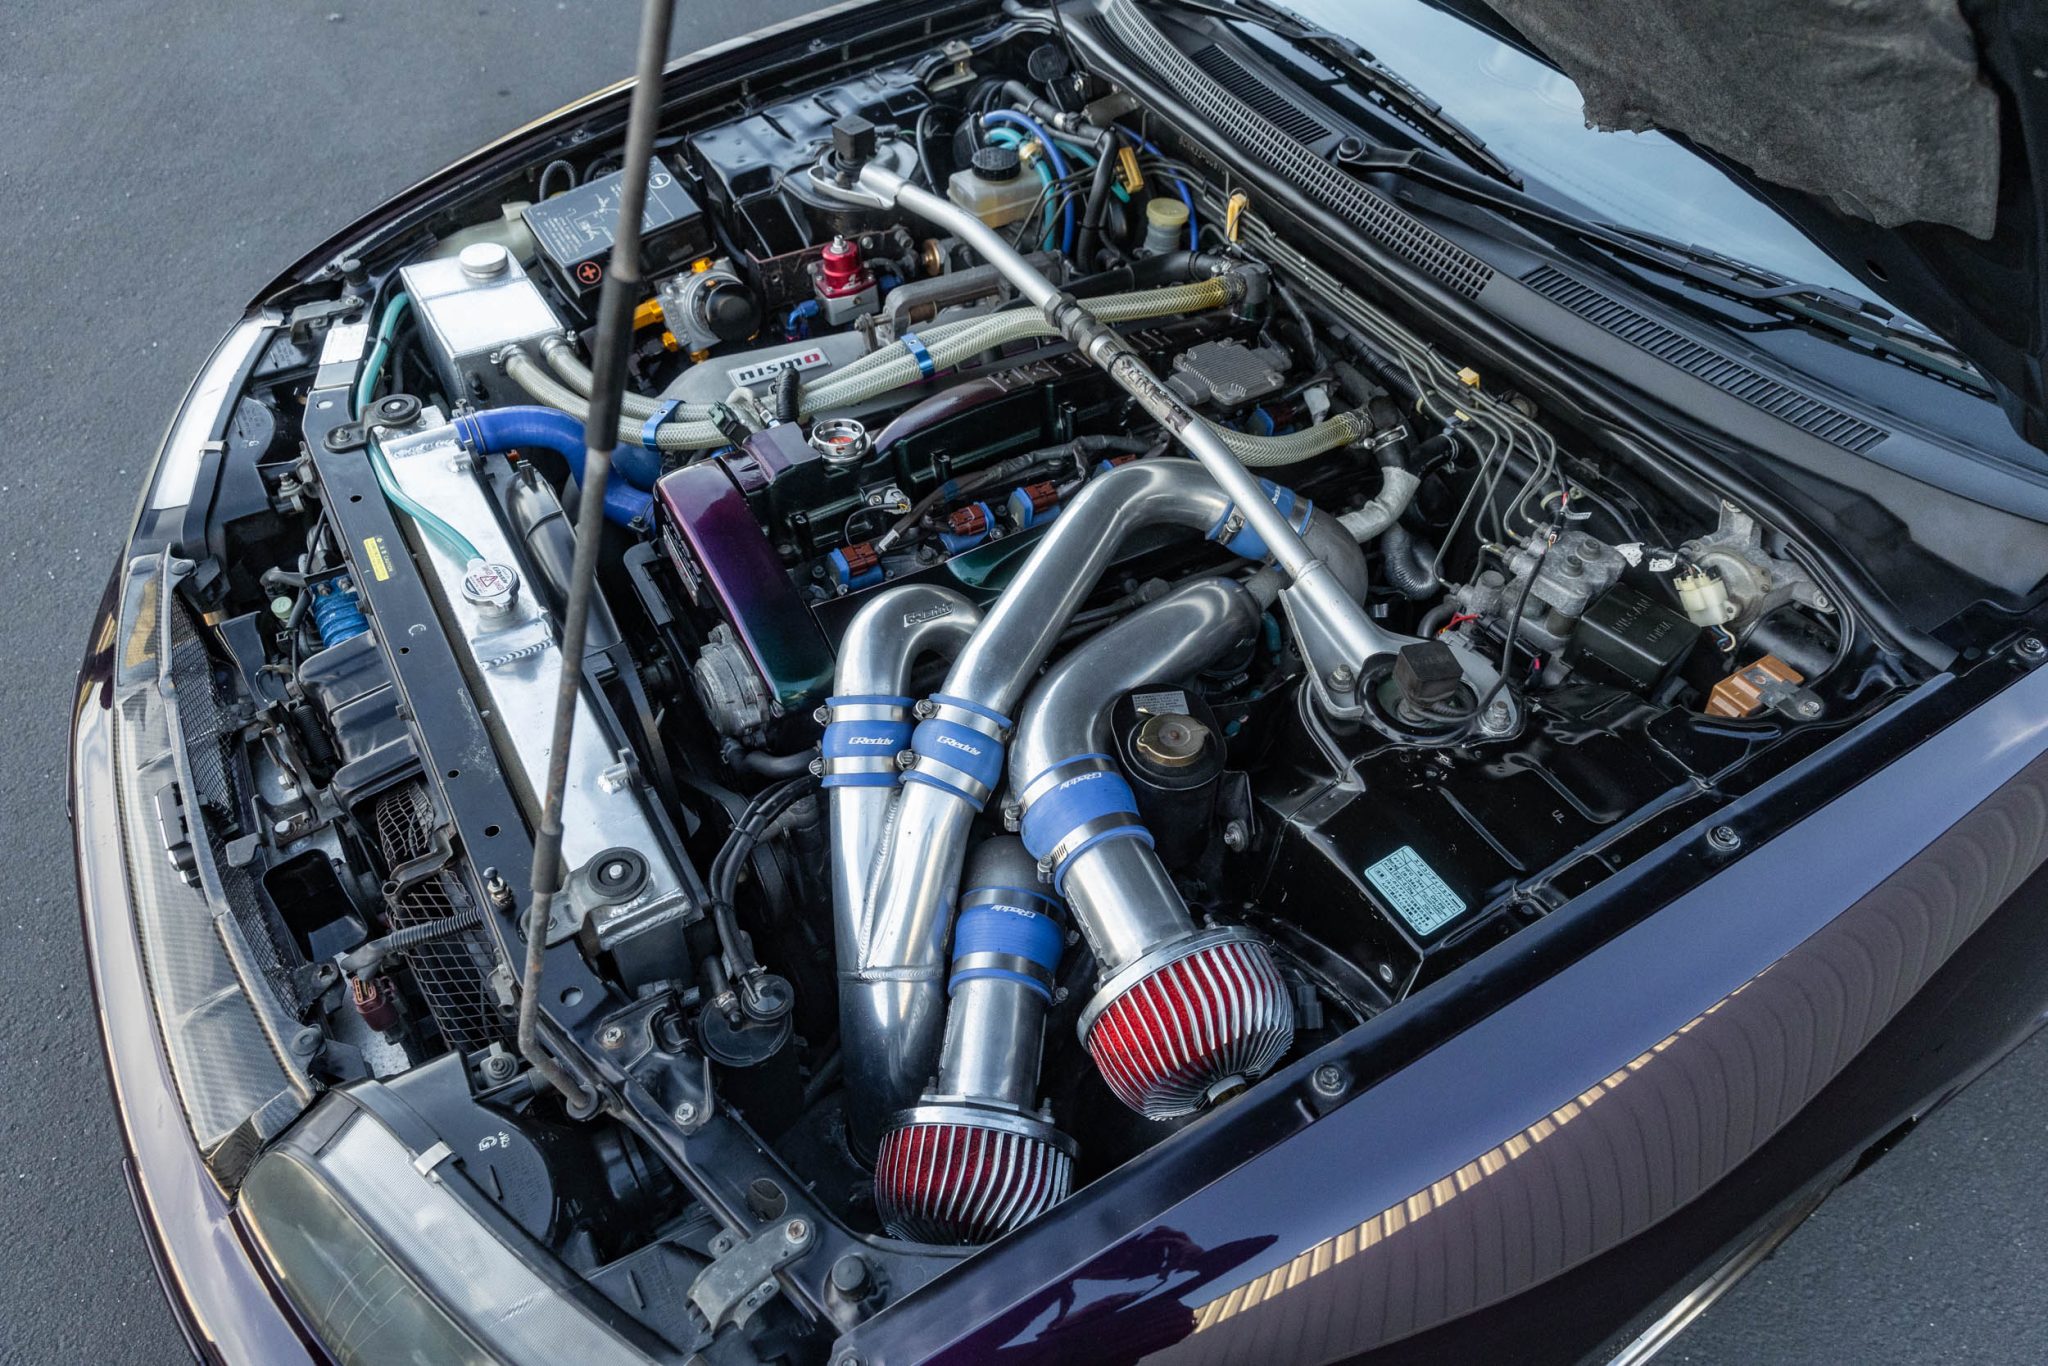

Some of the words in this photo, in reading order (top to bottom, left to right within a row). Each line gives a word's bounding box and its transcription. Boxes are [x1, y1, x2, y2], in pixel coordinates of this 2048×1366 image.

[848, 736, 894, 745] GReddy
[937, 735, 981, 756] GReddy
[991, 904, 1036, 918] GReddy
